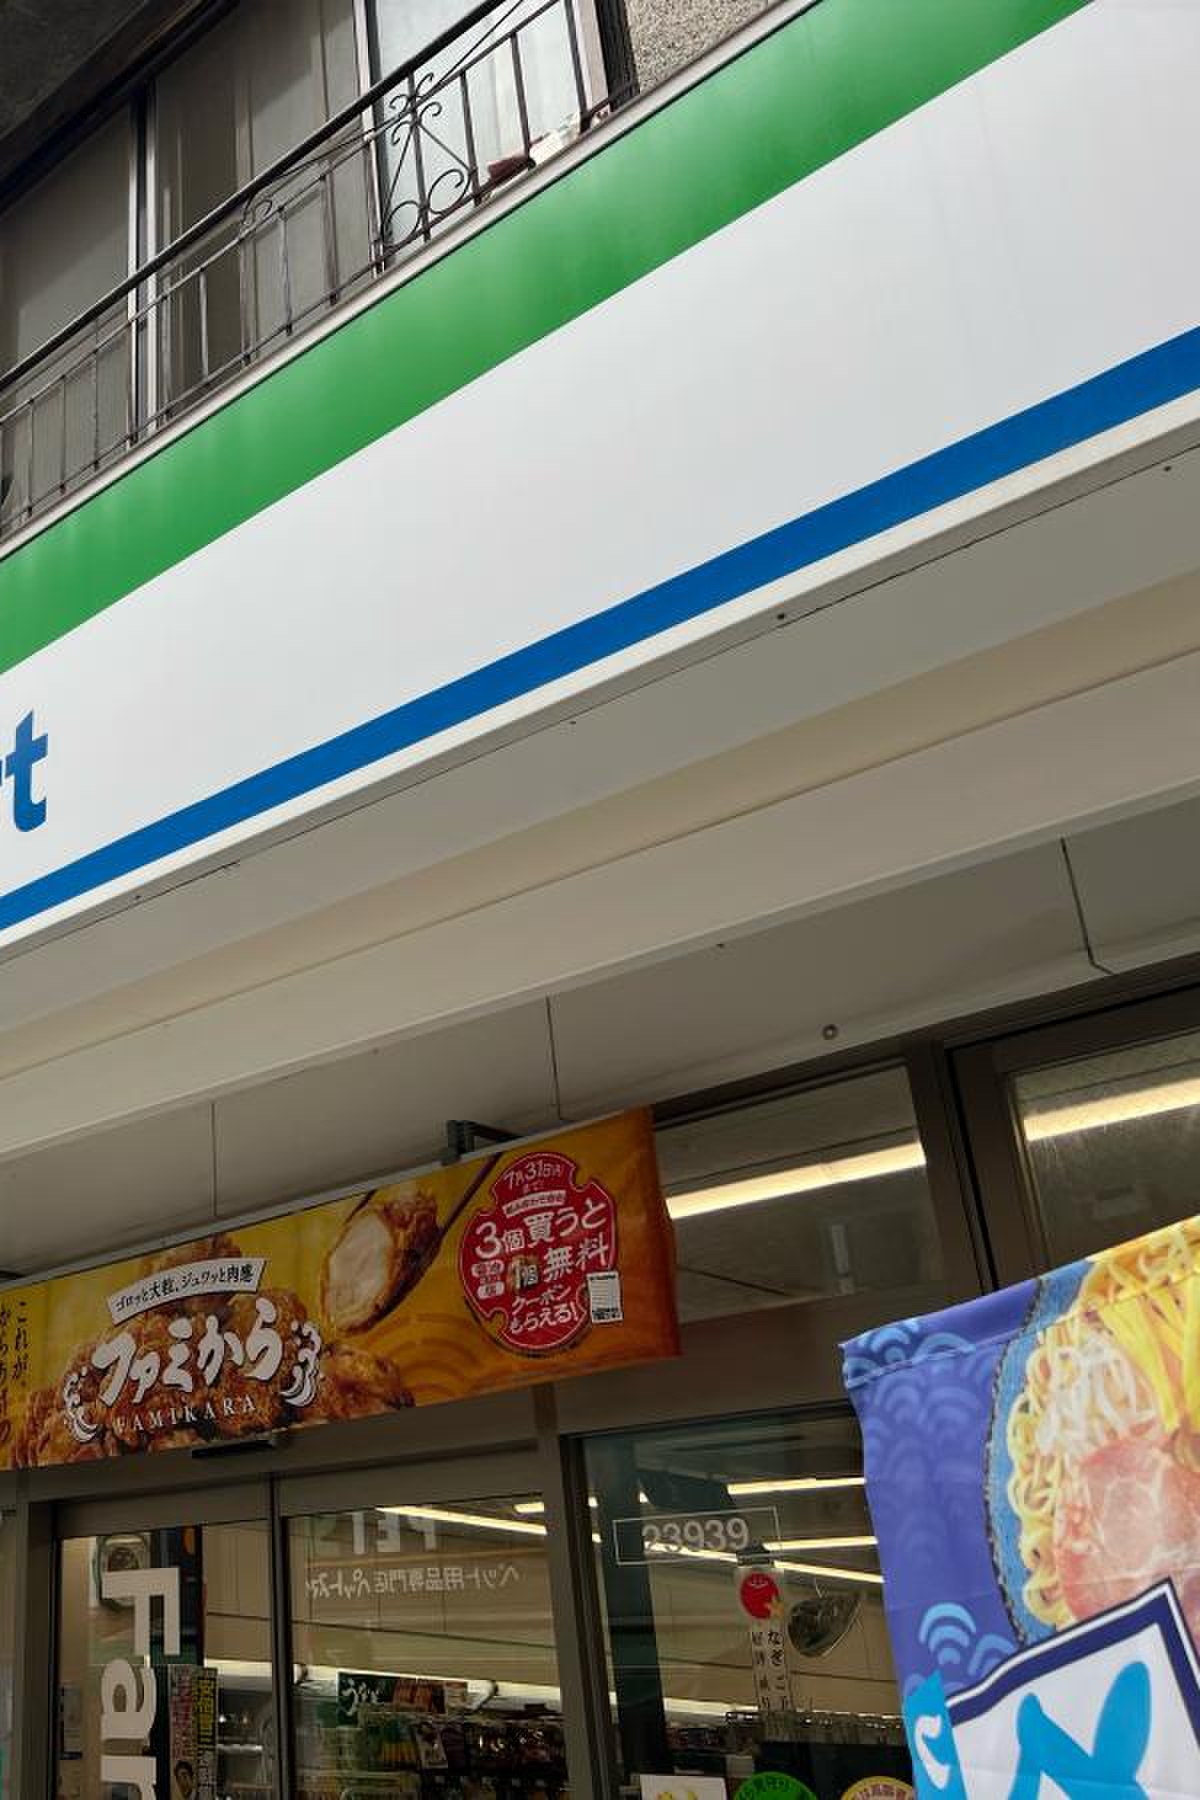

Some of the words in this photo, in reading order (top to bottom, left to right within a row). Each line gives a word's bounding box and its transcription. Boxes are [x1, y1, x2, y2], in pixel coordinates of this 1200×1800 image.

[91, 1297, 283, 1407] ファミから
[641, 1518, 749, 1552] 23939
